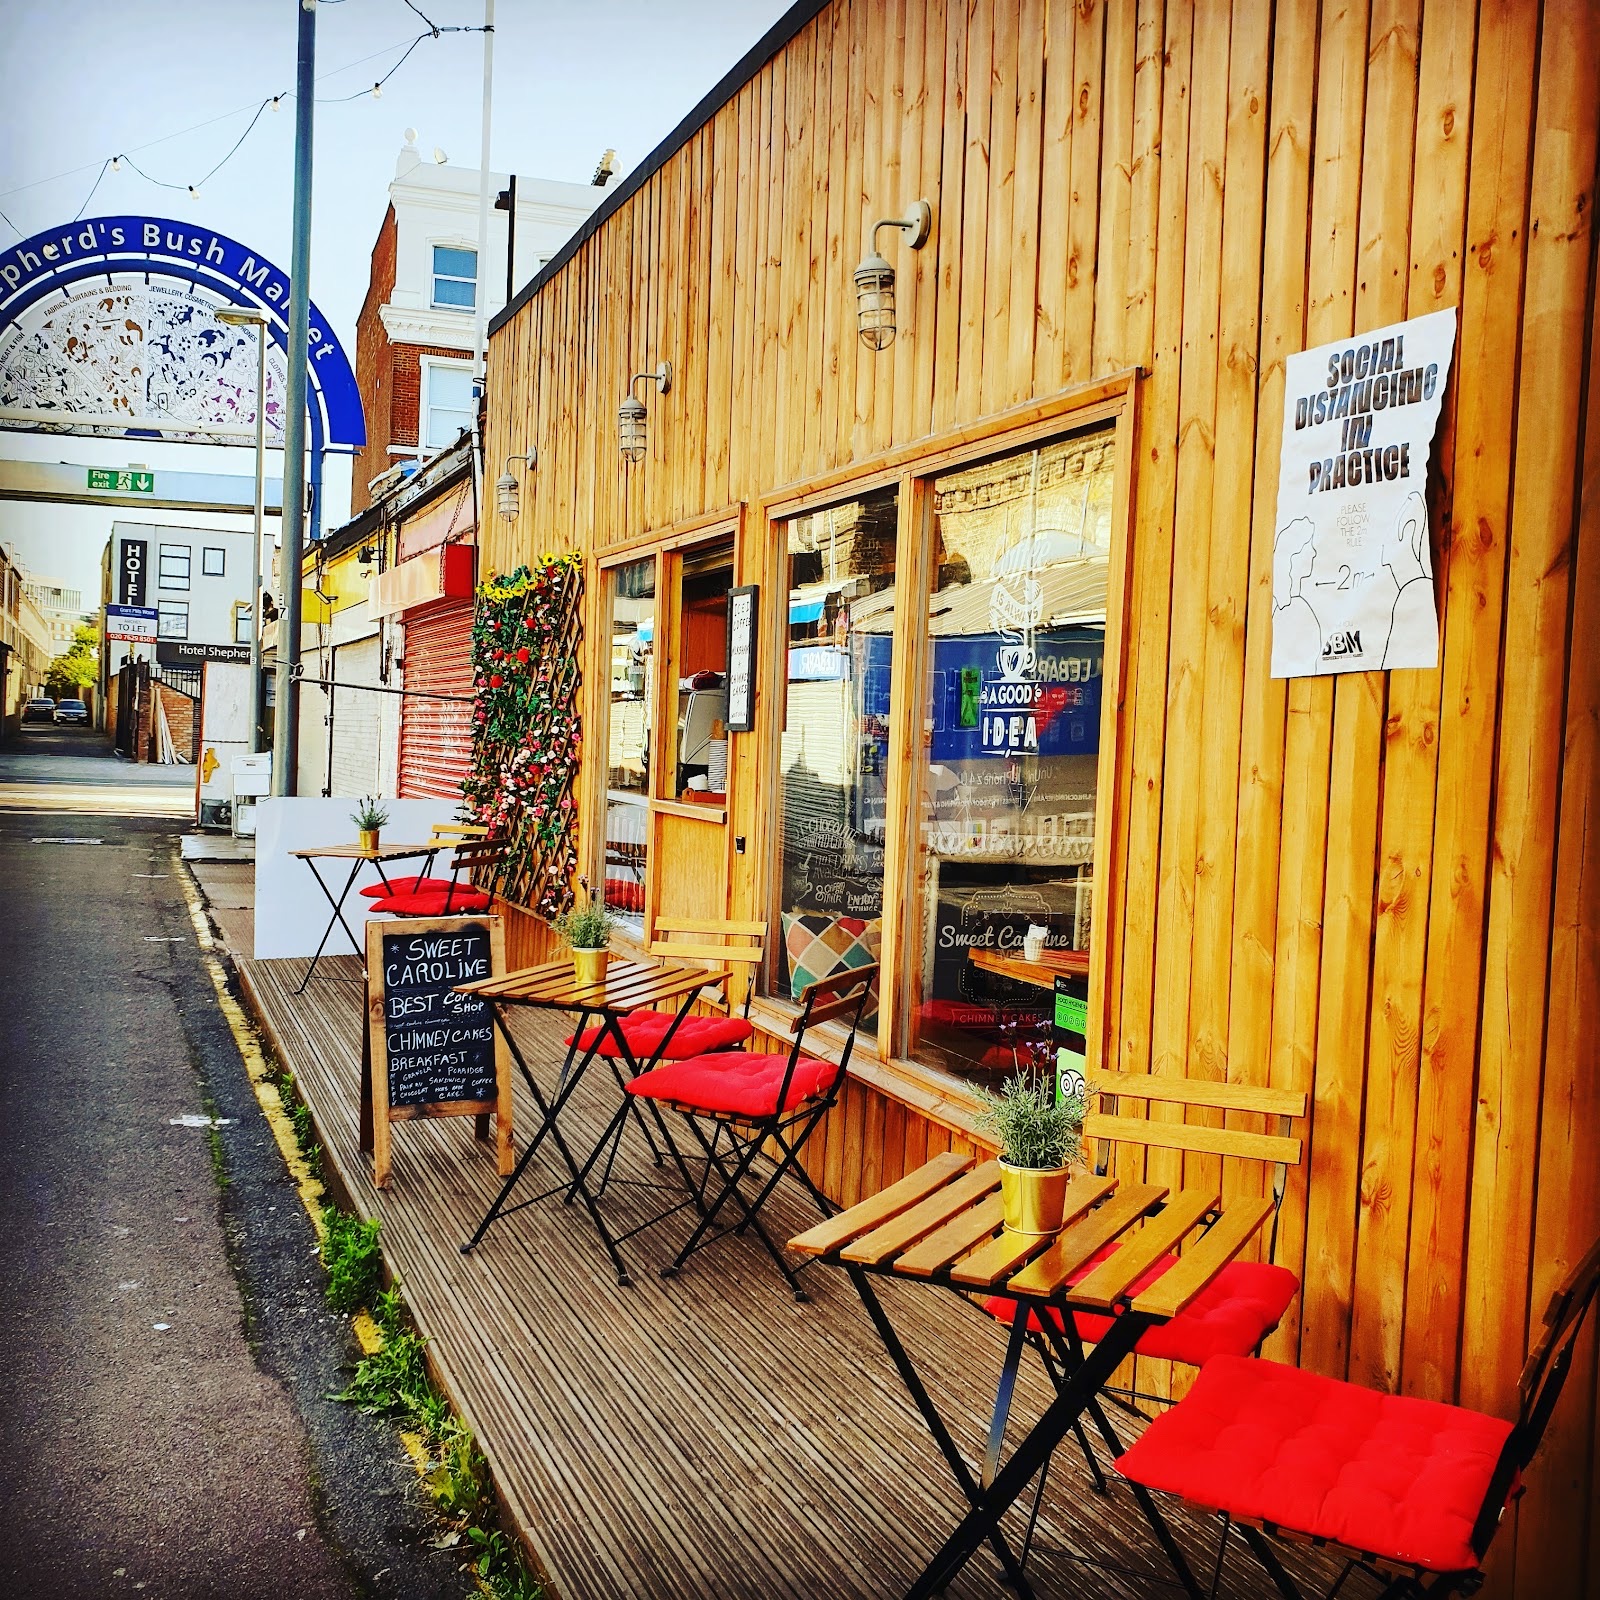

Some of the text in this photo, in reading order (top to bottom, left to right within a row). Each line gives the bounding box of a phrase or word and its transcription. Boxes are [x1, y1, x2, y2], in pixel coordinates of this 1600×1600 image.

[0, 223, 125, 294] pherd's
[143, 223, 225, 265] Bush
[105, 284, 132, 293] BEDDING
[1326, 335, 1404, 388] SOCIAL
[1295, 363, 1438, 431] DISTANCING
[1340, 414, 1373, 452] IN
[92, 470, 110, 480] Fire
[1308, 442, 1410, 495] PRACTICE
[92, 480, 110, 489] exit
[1341, 502, 1366, 514] PLEASE
[1336, 514, 1370, 526] FOLLOW
[1340, 527, 1355, 537] THE
[1346, 537, 1362, 547] RULE
[1337, 564, 1365, 590] 2m
[279, 607, 287, 619] 7
[1005, 601, 1039, 623] ALWAYS
[117, 623, 130, 632] TO
[179, 645, 252, 660] Hotel Shepher
[989, 685, 1033, 705] A GOOD
[939, 925, 1070, 949] Sweet Caine
[405, 937, 480, 960] SWEET
[389, 994, 439, 1018] BEST
[452, 1002, 485, 1013] SHOP
[959, 1013, 1043, 1024] CHIMNEY CAKES
[451, 1027, 492, 1042] CAKES
[390, 1051, 468, 1072] BREAKFAST
[402, 1066, 484, 1081] GRANOLA PORRIDGE
